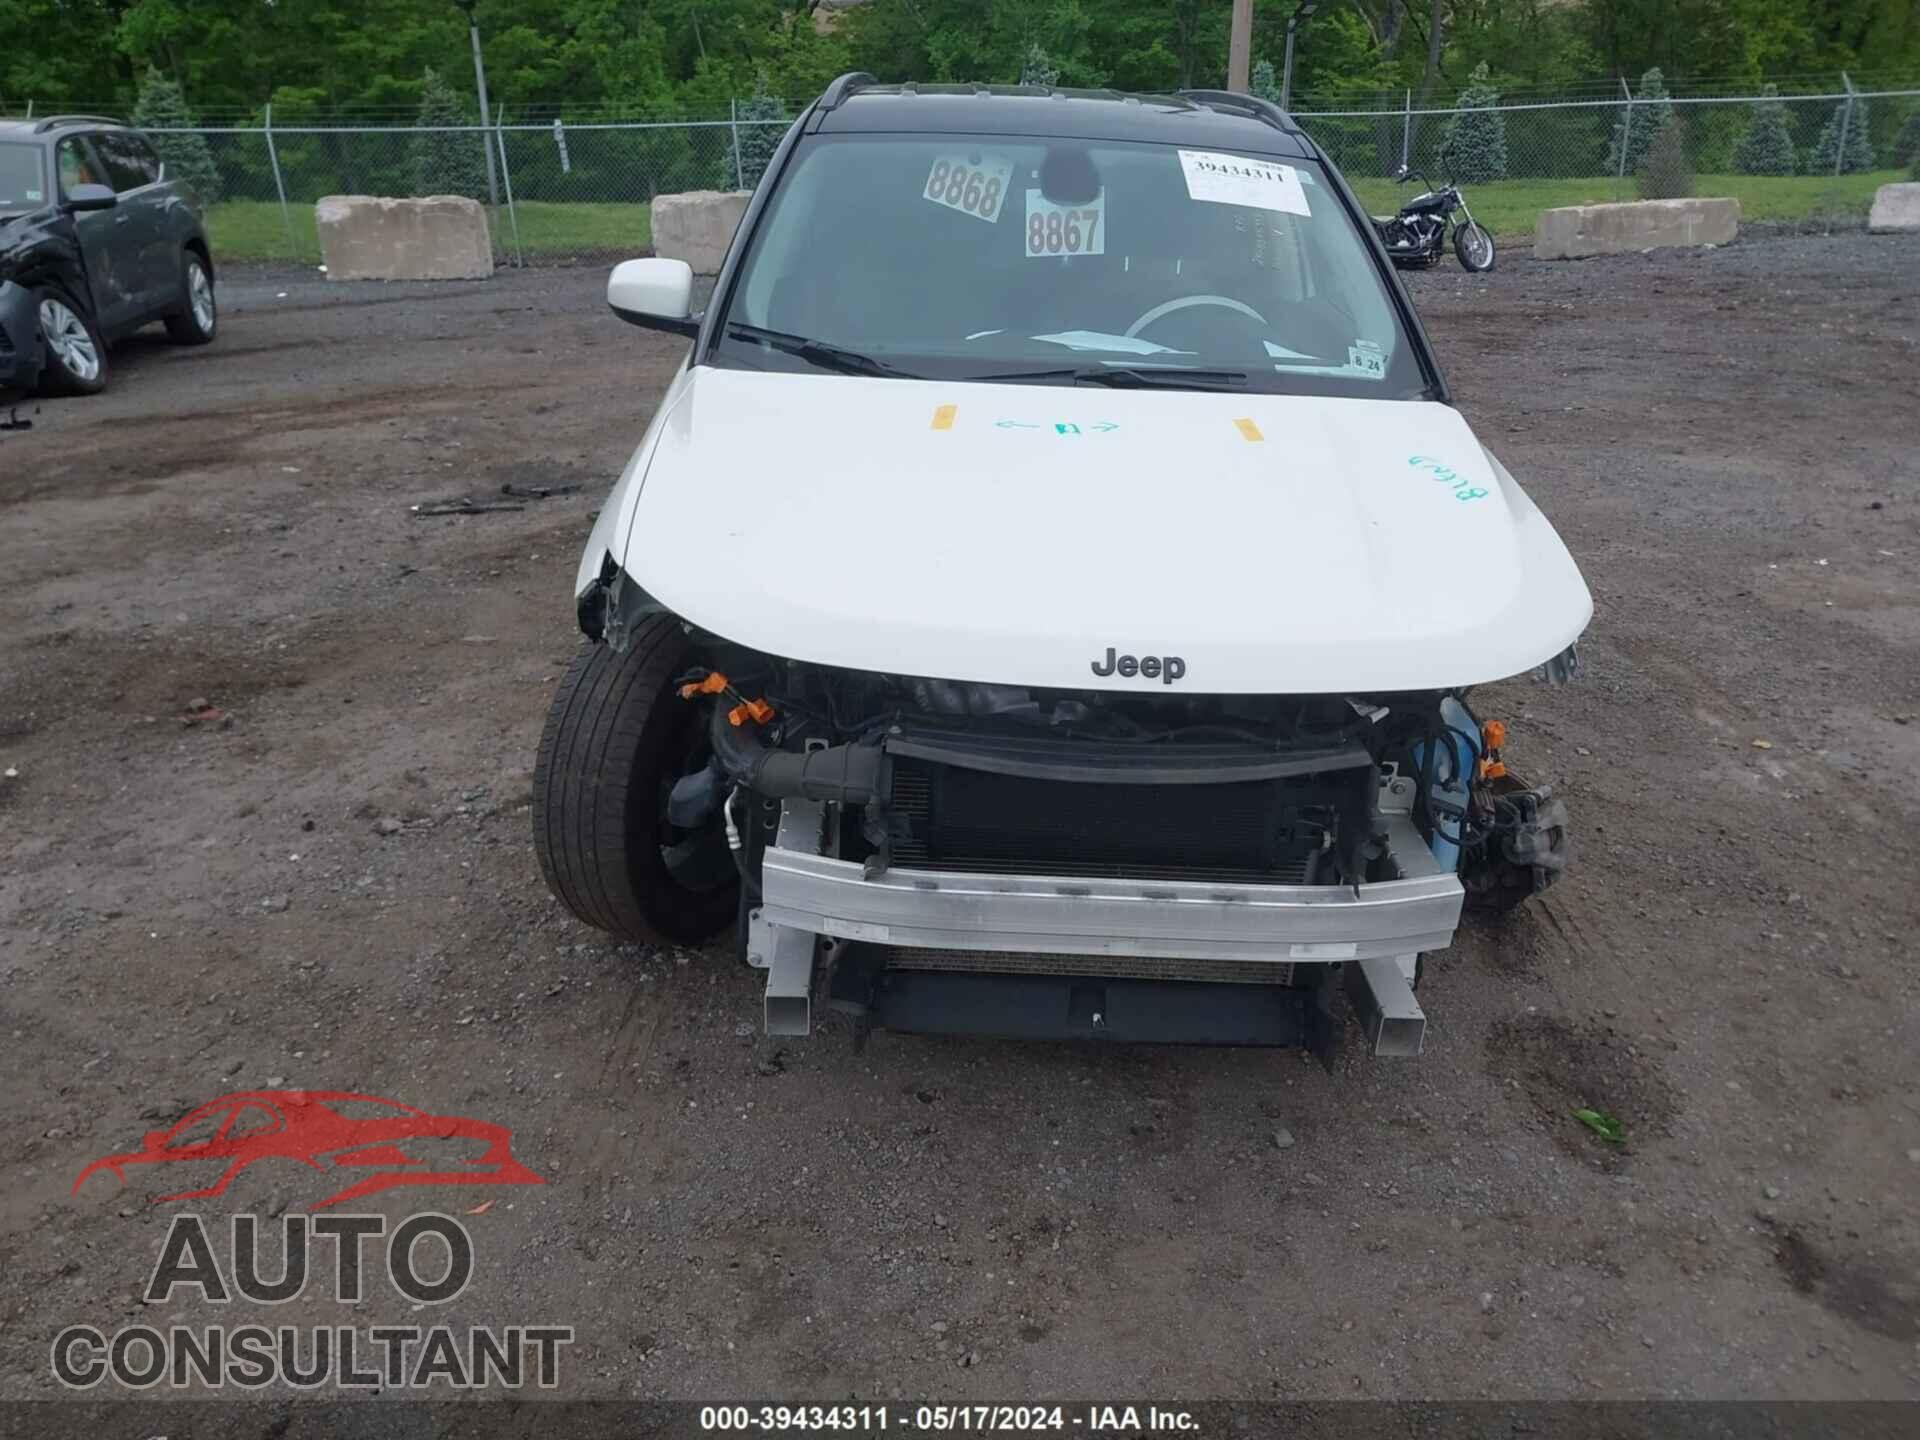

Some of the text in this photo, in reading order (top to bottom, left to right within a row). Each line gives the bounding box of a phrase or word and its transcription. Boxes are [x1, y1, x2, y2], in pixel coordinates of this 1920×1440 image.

[927, 160, 1001, 218] 8868
[1194, 160, 1285, 183] 39434311
[1028, 209, 1100, 255] 8867
[1090, 647, 1186, 685] Jeep
